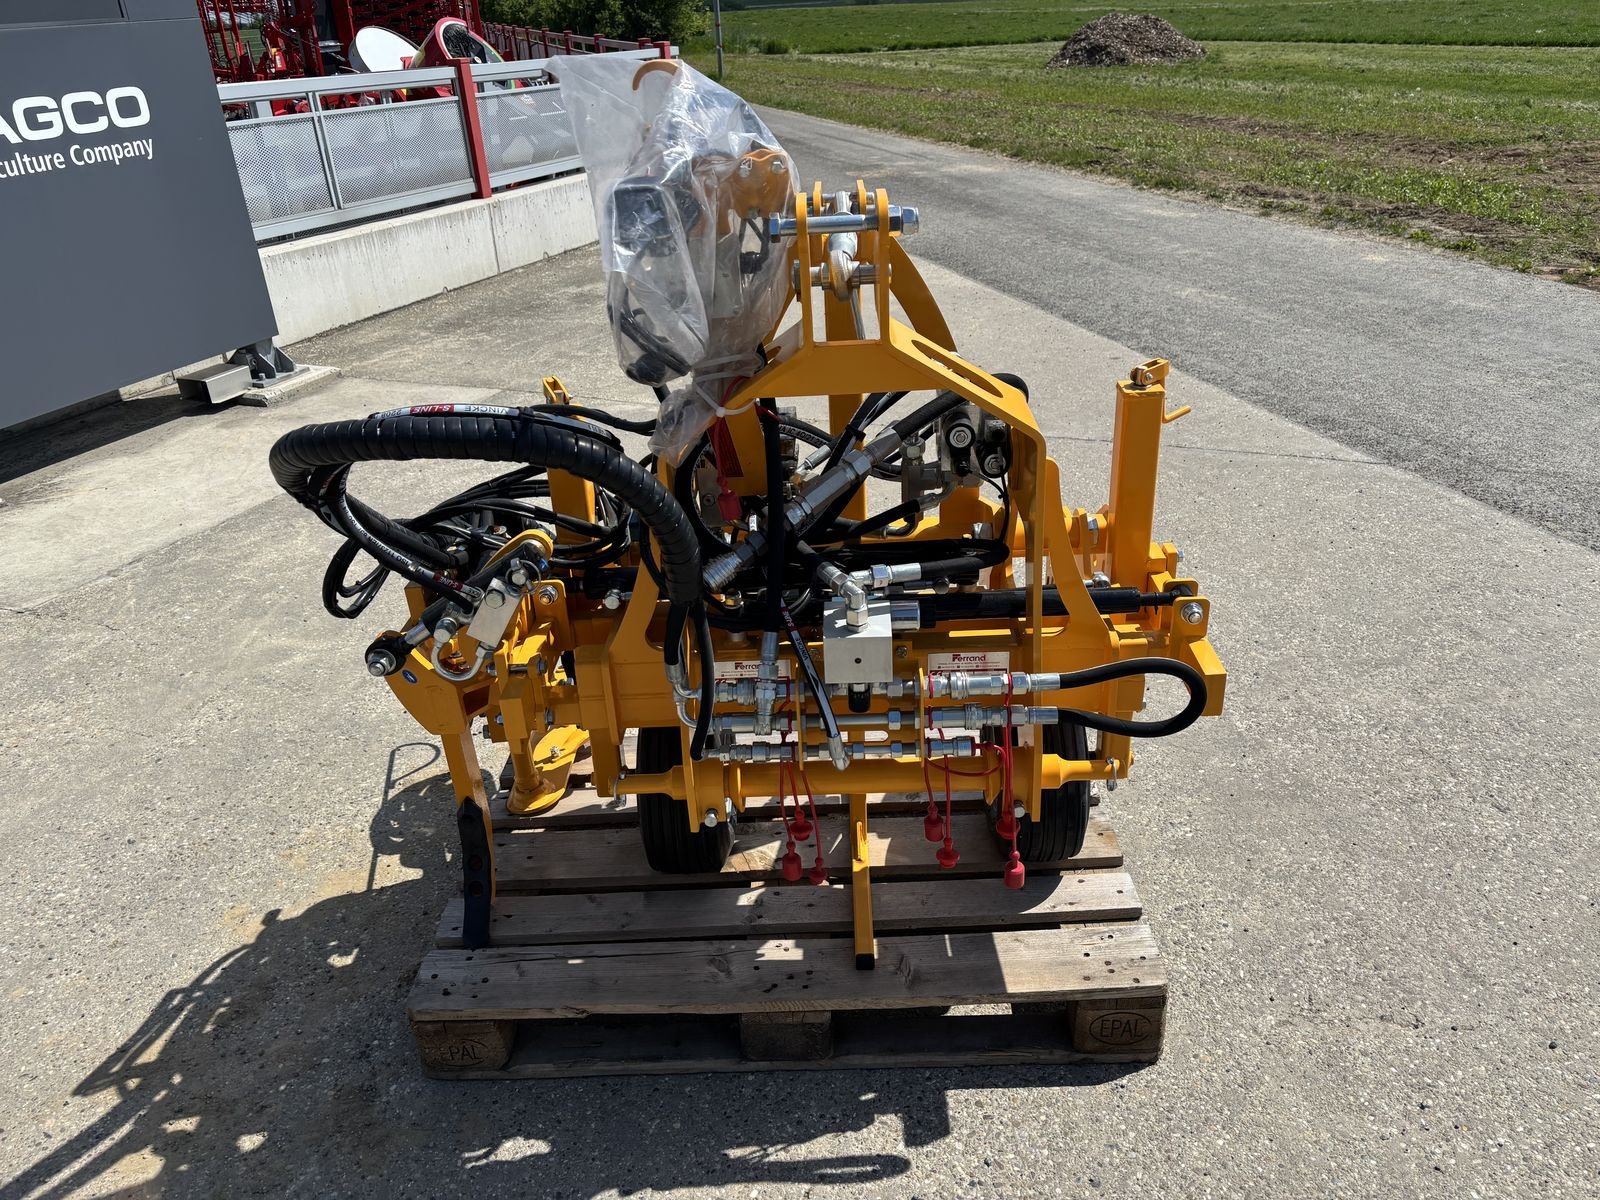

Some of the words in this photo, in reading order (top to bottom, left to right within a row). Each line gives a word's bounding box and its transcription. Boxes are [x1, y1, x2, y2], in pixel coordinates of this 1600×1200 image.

[69, 138, 153, 166] Company
[412, 404, 451, 414] S-LINE
[464, 404, 508, 415] VINCKE
[951, 653, 986, 662] Ferrand
[1099, 1019, 1143, 1038] EPAL
